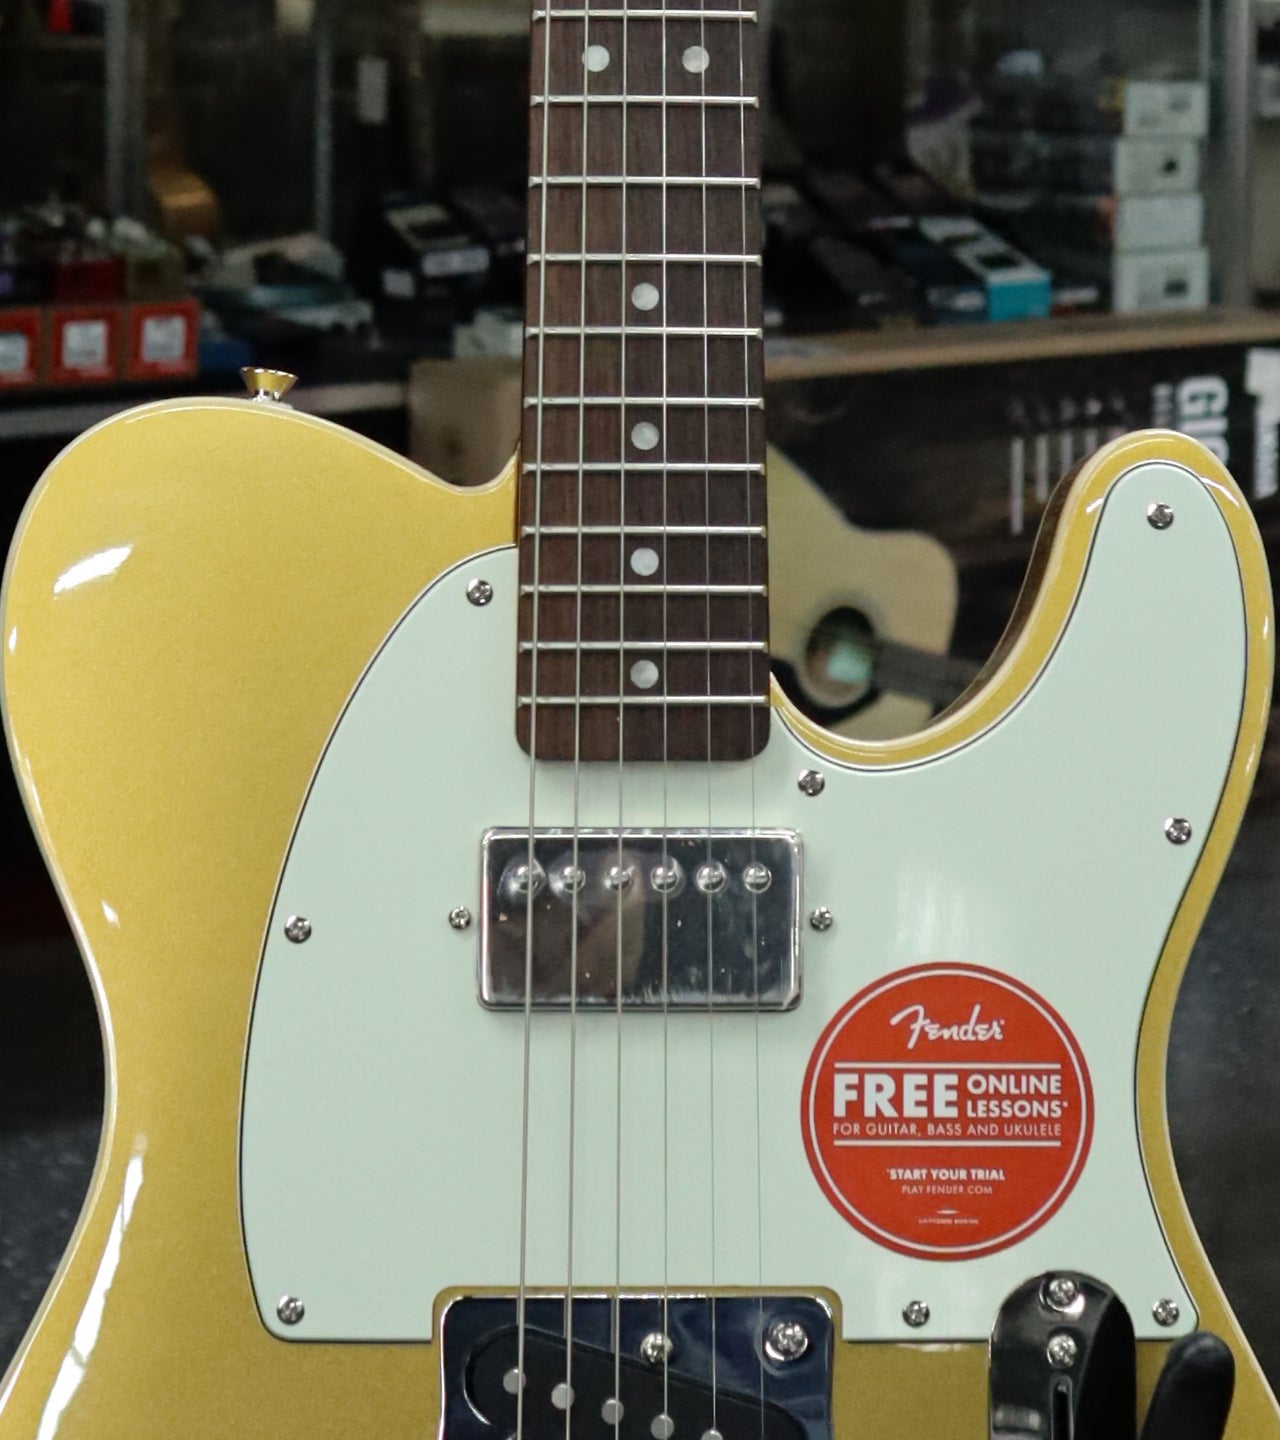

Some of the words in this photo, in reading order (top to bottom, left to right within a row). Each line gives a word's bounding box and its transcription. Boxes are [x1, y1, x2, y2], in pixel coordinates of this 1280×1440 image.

[890, 1003, 1004, 1049] Fender
[833, 1073, 959, 1118] FREE
[967, 1074, 1062, 1095] ONLINE
[833, 1122, 860, 1136] FOR
[866, 1122, 922, 1137] GUITAR,
[927, 1123, 962, 1136] BASS
[967, 1123, 999, 1136] AND
[1004, 1123, 1061, 1136] UKULELE
[930, 1168, 968, 1180] YOUR
[970, 1168, 1006, 1180] TRIAL
